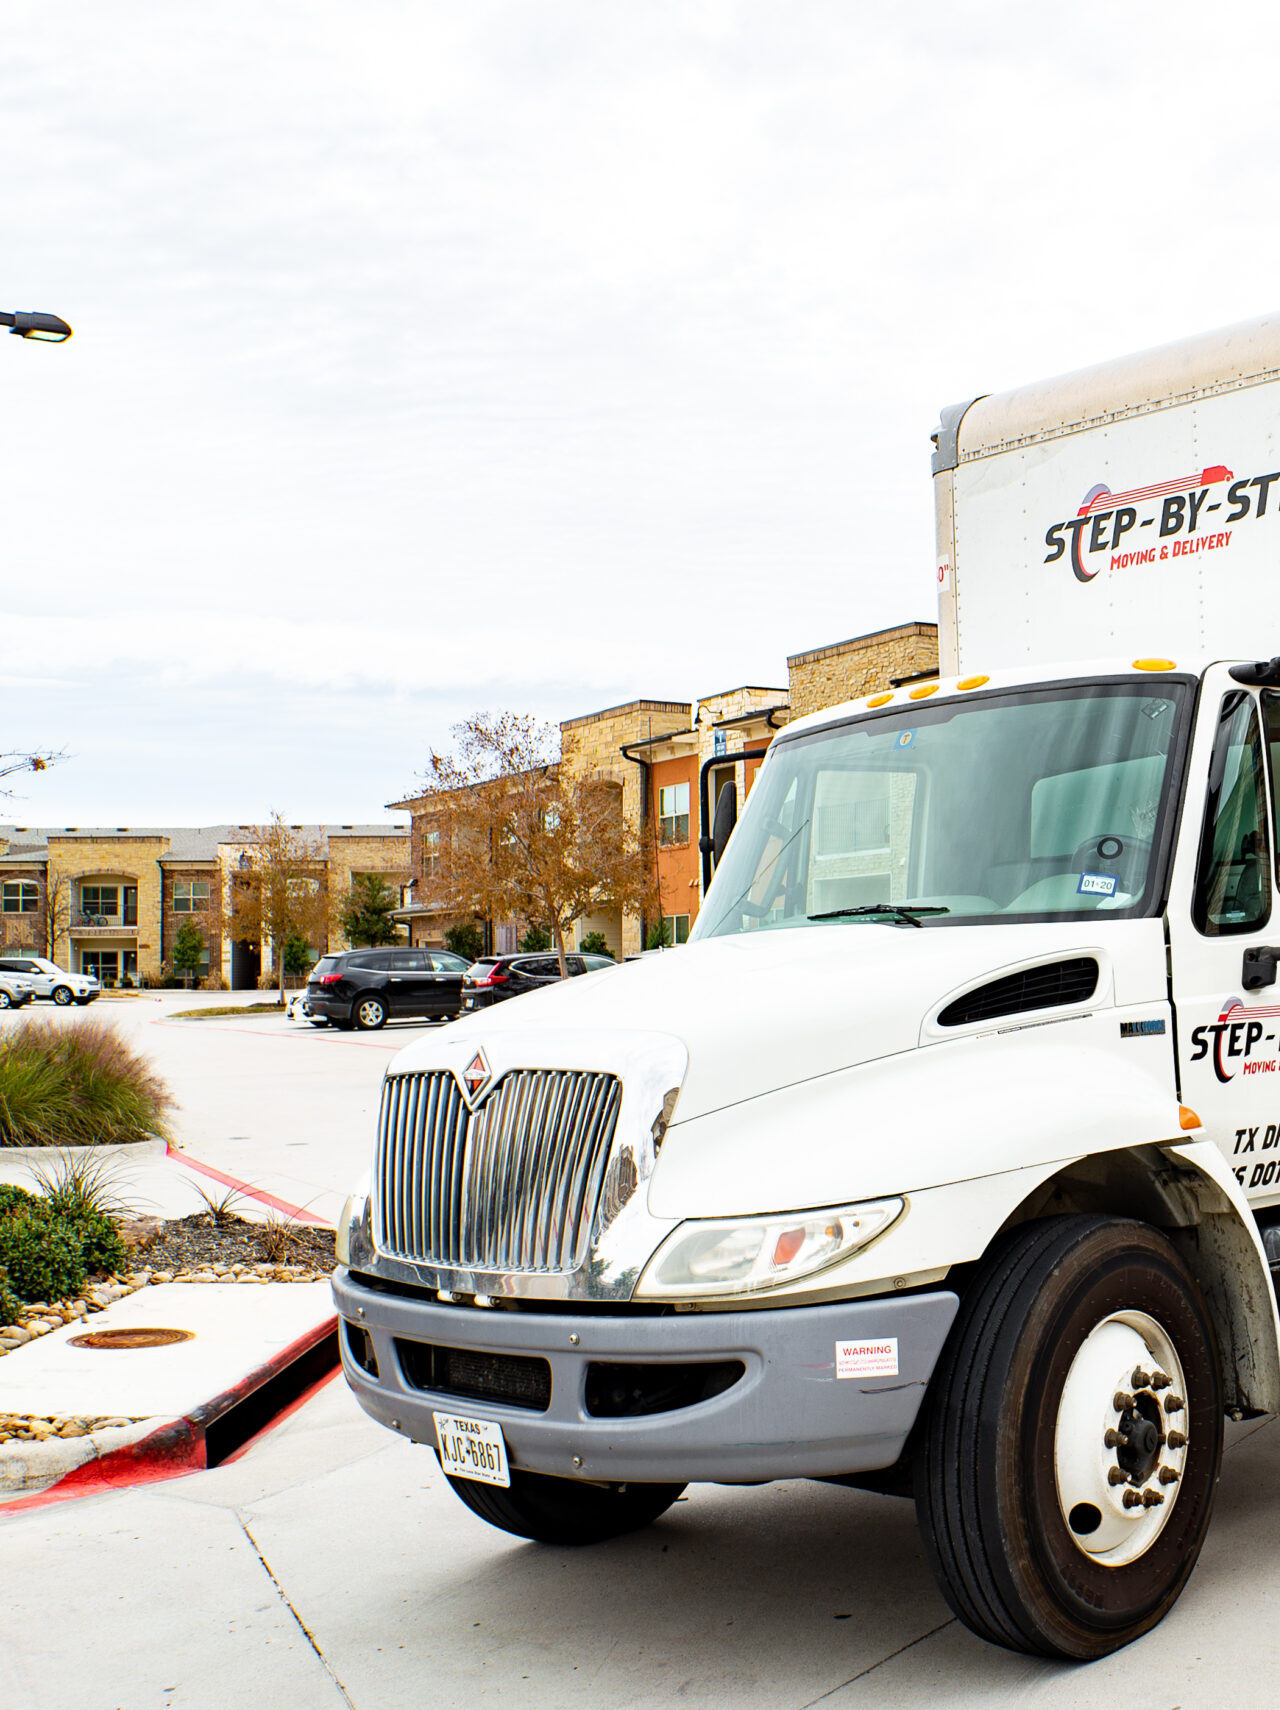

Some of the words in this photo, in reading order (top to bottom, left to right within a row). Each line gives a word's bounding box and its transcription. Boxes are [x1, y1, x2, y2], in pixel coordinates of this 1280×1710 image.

[1110, 547, 1156, 571] MOVING
[1160, 545, 1169, 560] &
[1172, 531, 1233, 558] DELIVERY
[1243, 1059, 1276, 1076] MOVING
[1233, 1127, 1260, 1155] TX
[1232, 1165, 1248, 1187] S
[842, 1345, 892, 1356] WARNING
[453, 1419, 481, 1435] TEXAS
